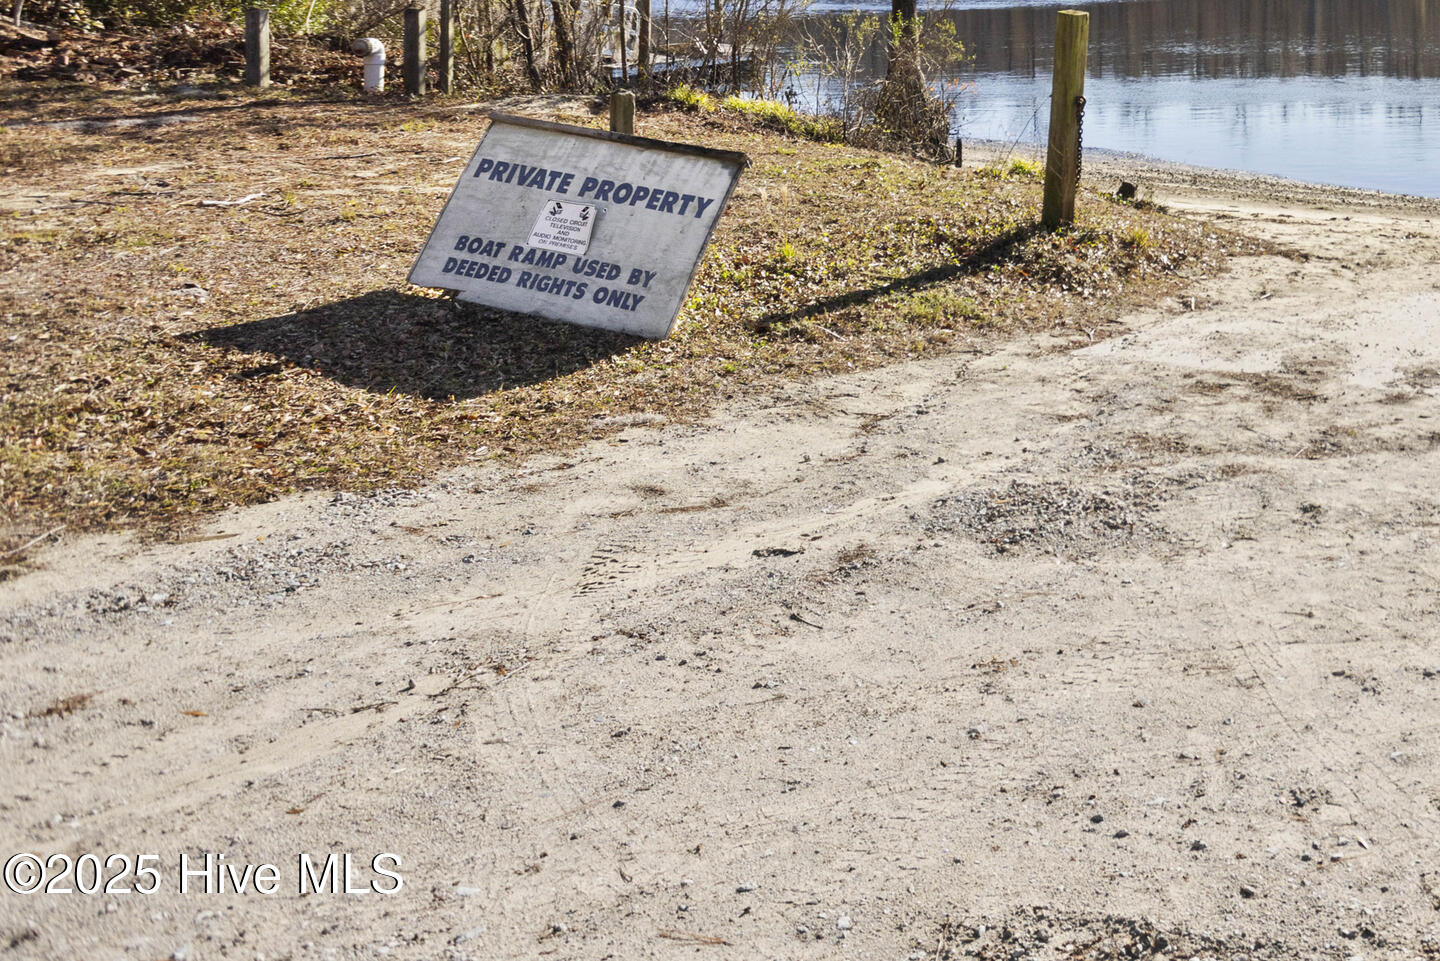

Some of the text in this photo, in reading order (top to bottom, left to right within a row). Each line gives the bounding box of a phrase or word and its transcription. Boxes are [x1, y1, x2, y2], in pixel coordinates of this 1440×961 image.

[473, 158, 714, 218] PRIVATE PROPERTY
[550, 223, 581, 232] TELEVISION
[552, 235, 586, 245] MONITORING
[549, 241, 578, 250] PREMISES
[454, 236, 657, 288] BOAT RAMP USED BY
[442, 257, 645, 311] DEEDED RIGHTS ONLY
